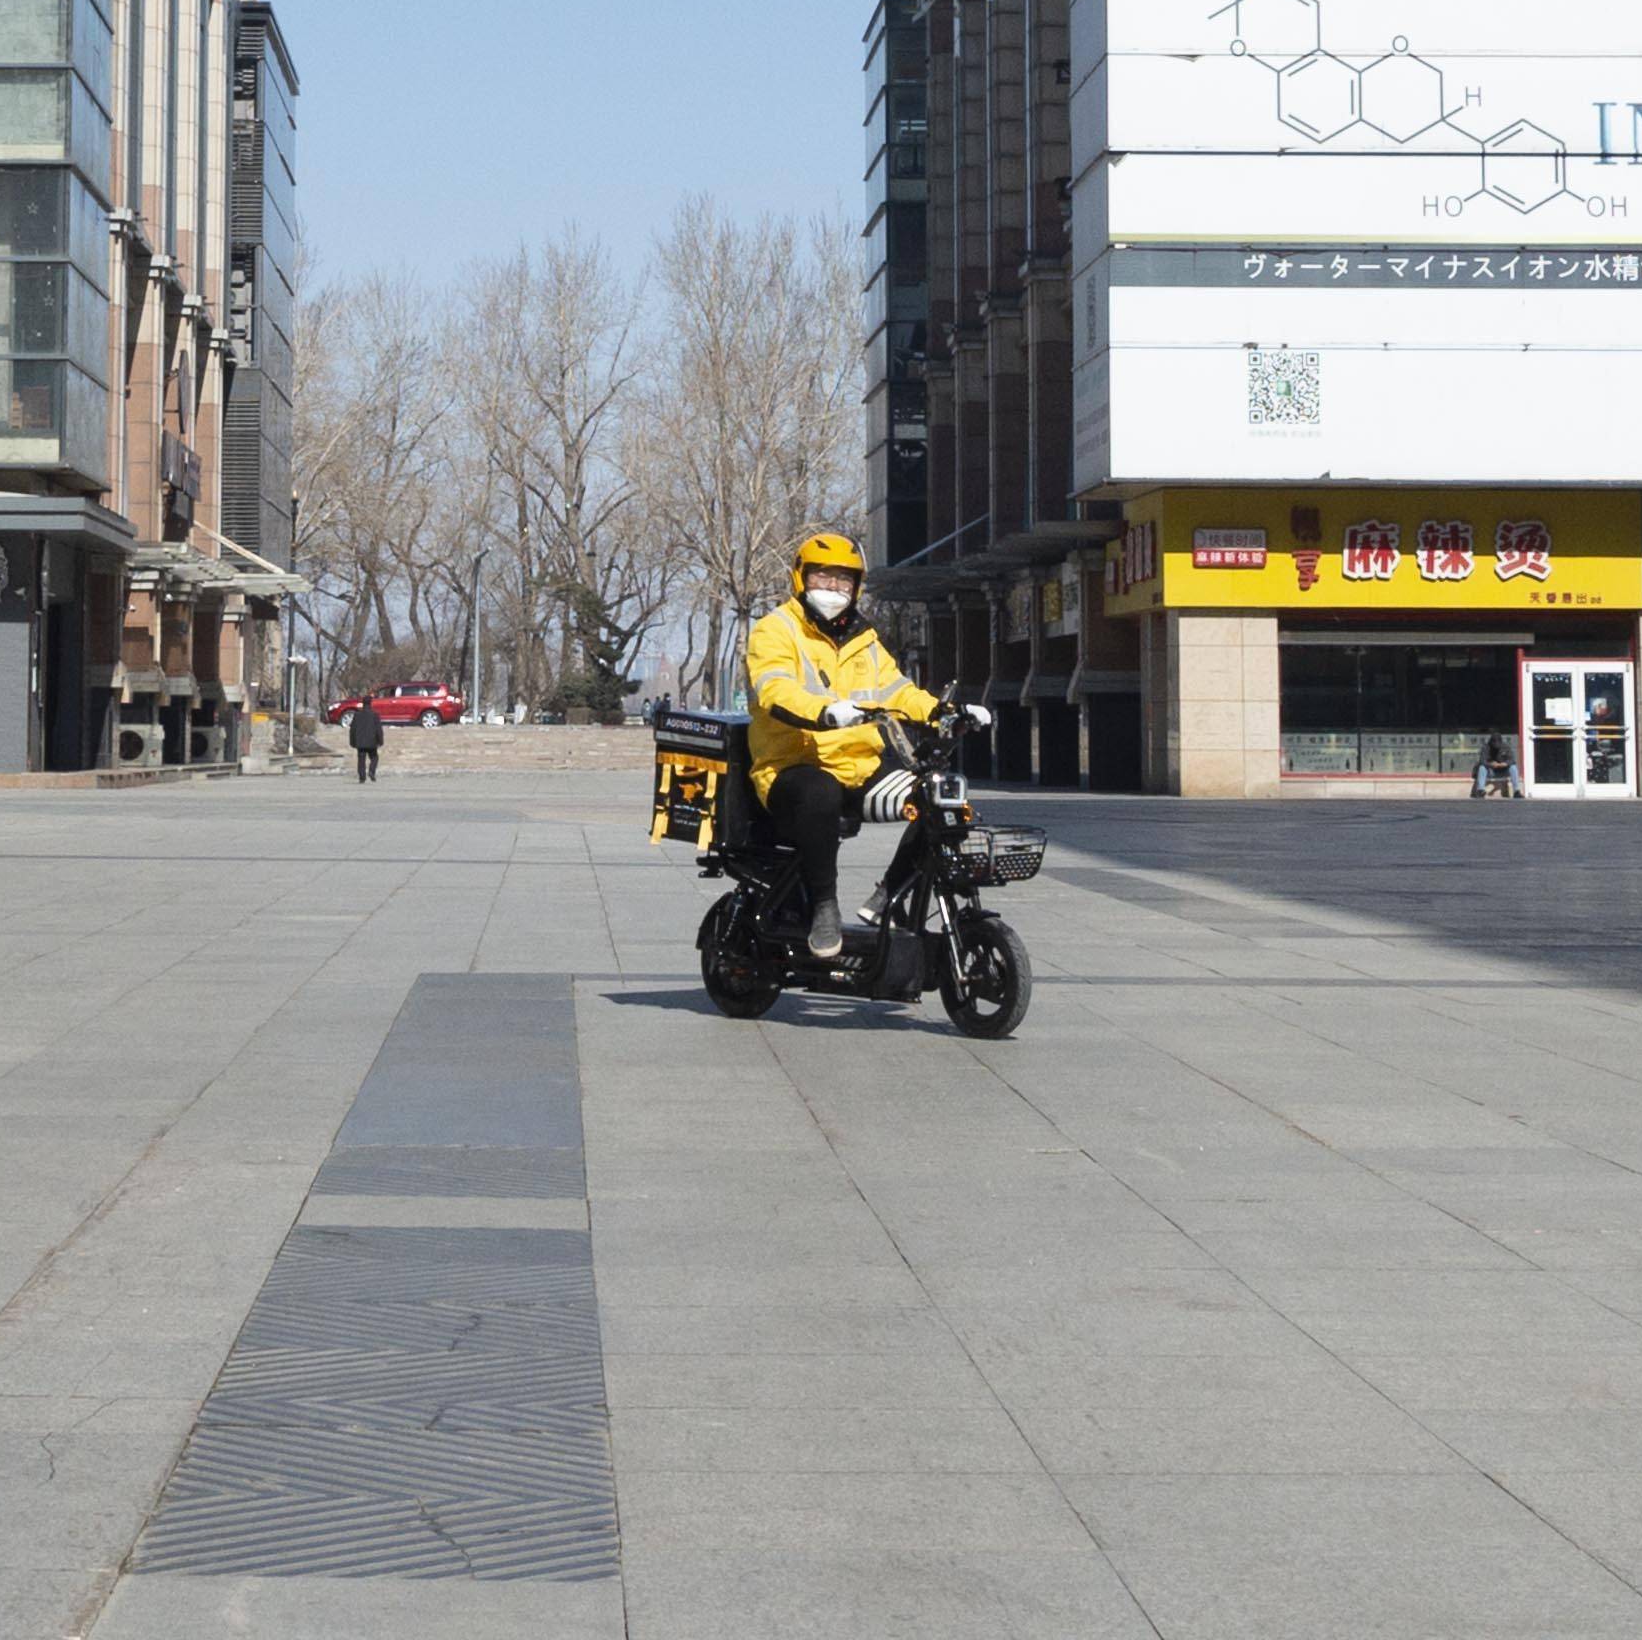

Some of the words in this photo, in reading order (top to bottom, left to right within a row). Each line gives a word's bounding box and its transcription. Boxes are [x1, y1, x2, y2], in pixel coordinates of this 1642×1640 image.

[1465, 86, 1482, 107] H
[1422, 195, 1464, 217] HO
[1586, 195, 1628, 217] OH
[1341, 519, 1553, 582] 麻辣烫
